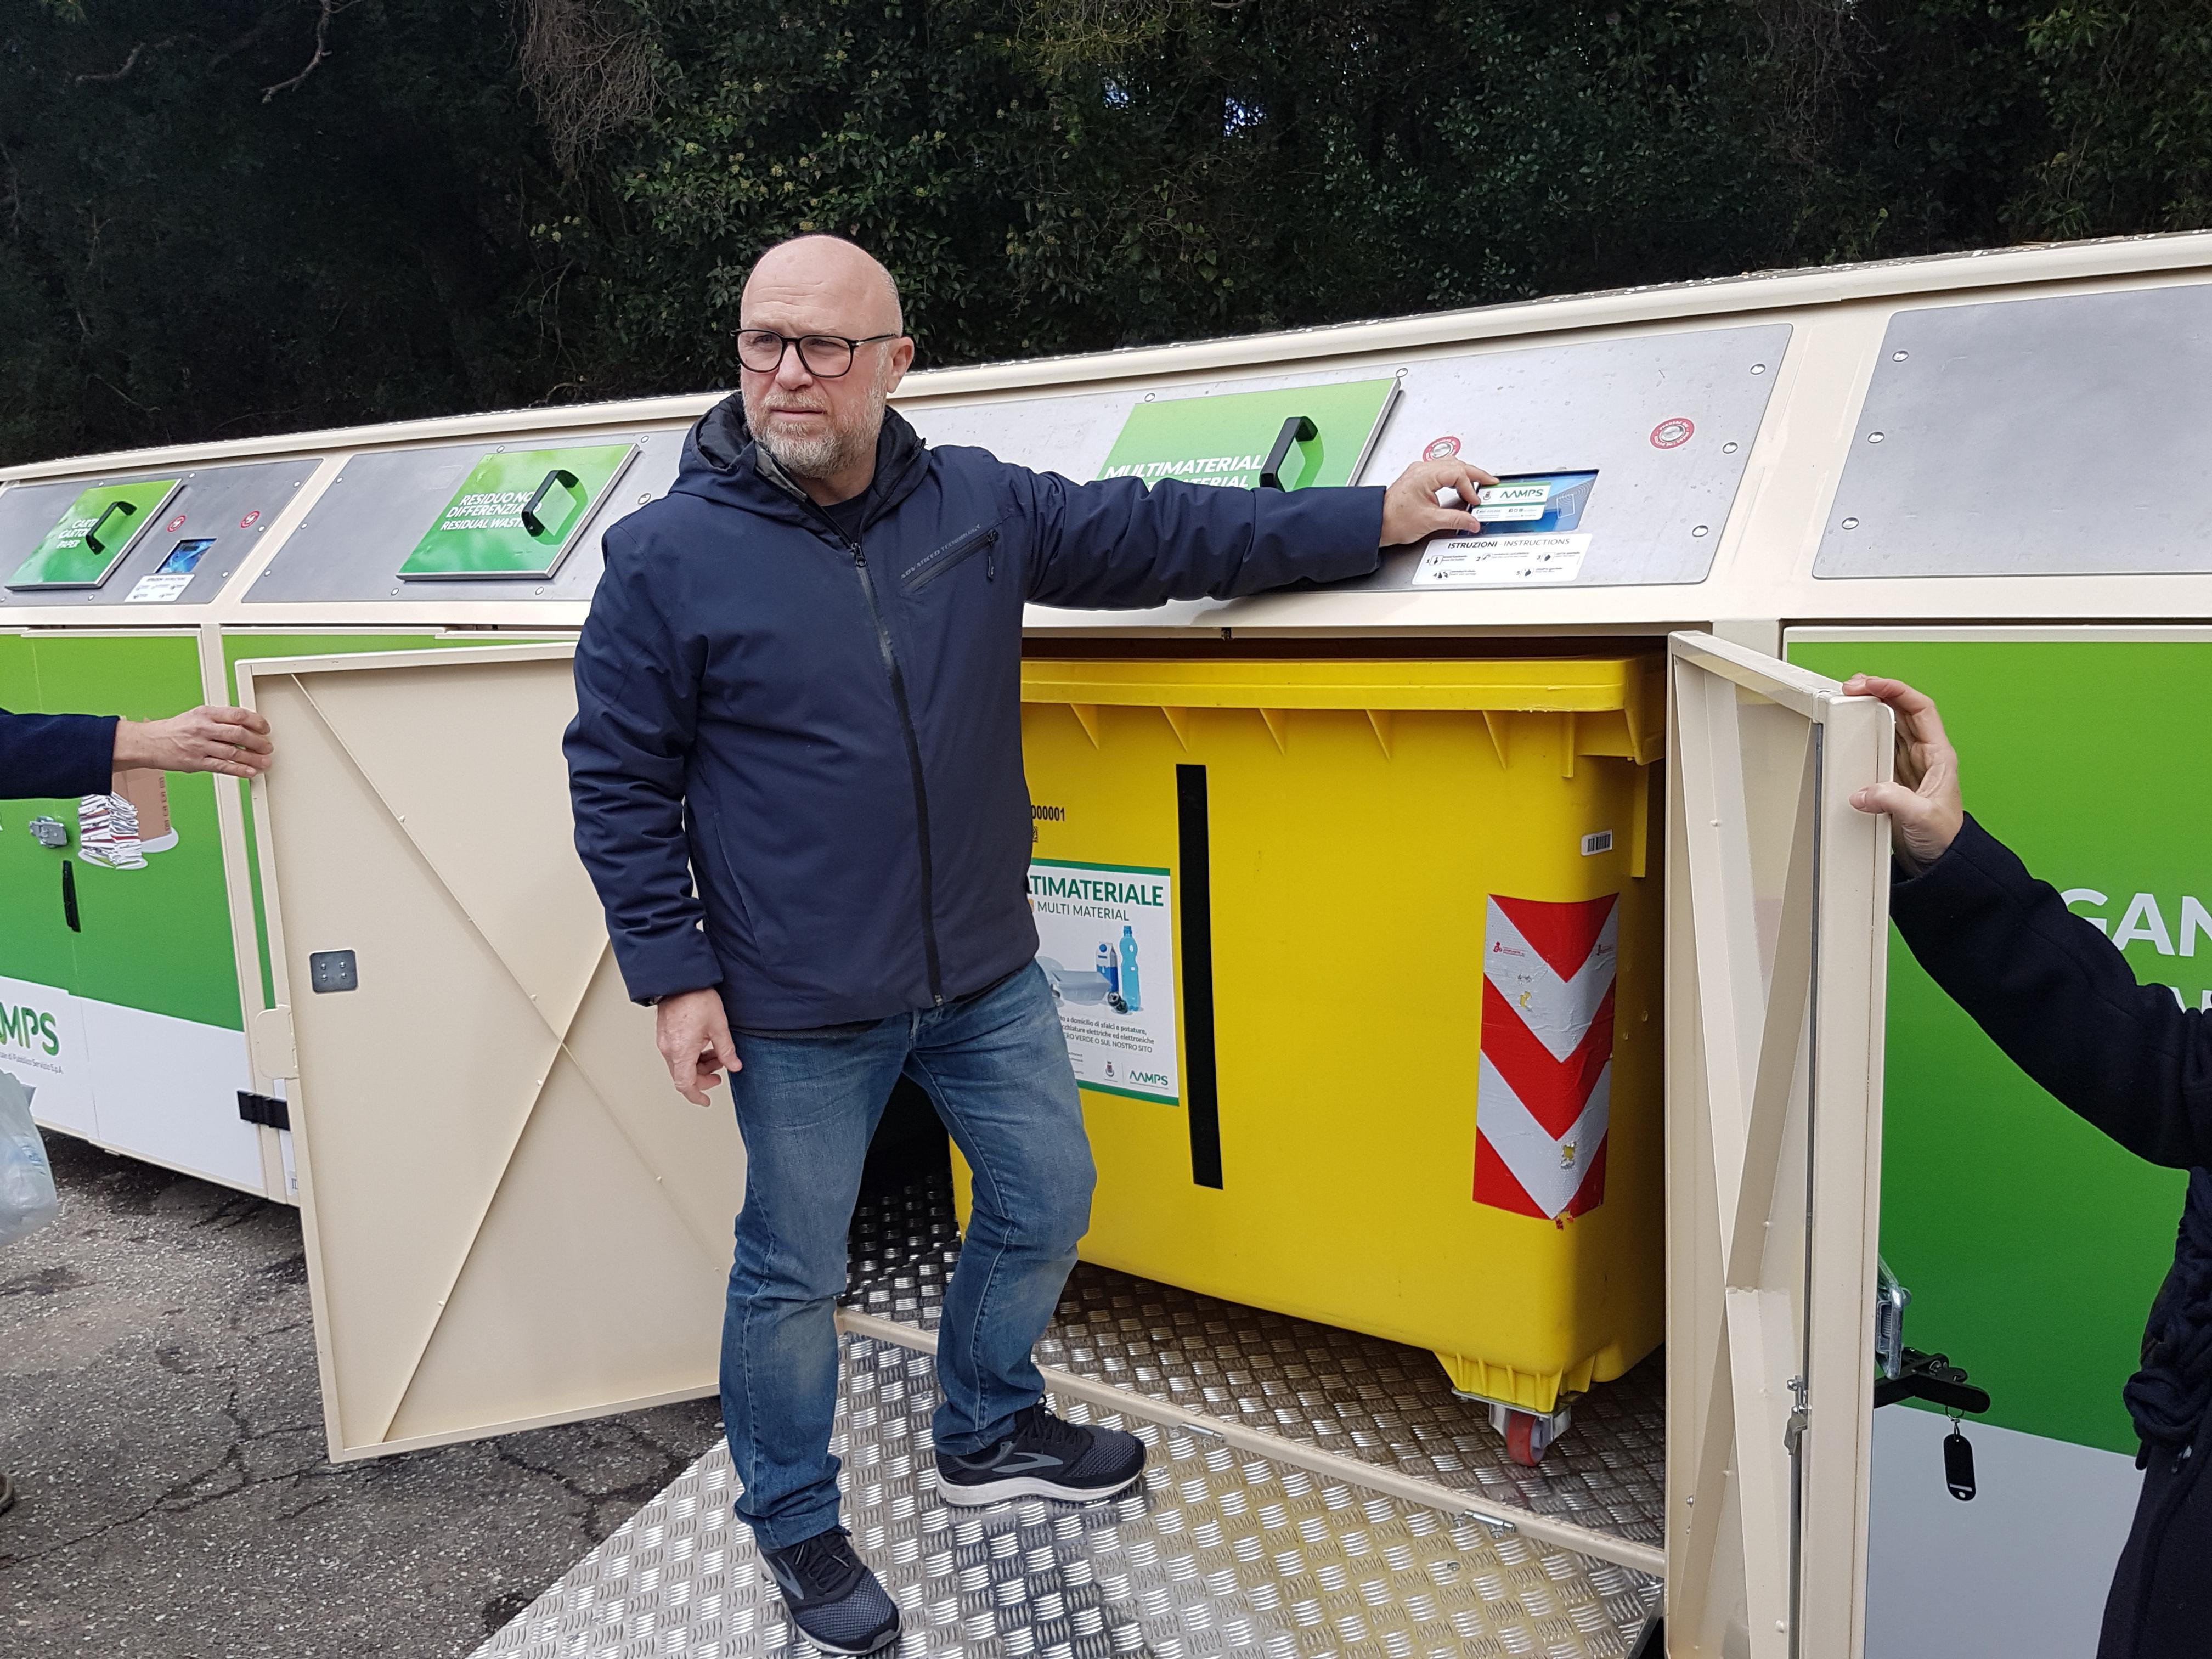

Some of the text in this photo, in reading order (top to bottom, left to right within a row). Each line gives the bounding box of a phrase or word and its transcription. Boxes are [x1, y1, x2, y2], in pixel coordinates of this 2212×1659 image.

[1103, 454, 1270, 479] MULTIMATERIAL
[459, 491, 536, 506] RESIDUO NO
[1500, 489, 1544, 498] AAMPS
[445, 501, 543, 518] DIFFERENZIAO
[440, 519, 488, 531] RESIDUAL
[900, 523, 981, 579] ADVANCED TECHNOLOGY
[1447, 538, 1571, 549] ISTRUZIONI INSTRUCTIONS
[1037, 901, 1130, 921] MULTI MATERIAL
[0, 1001, 60, 1056] MPS
[1062, 1024, 1085, 1033] cchiature
[1086, 1028, 1111, 1037] elettriche
[1120, 1034, 1154, 1044] elettroniche
[1070, 1017, 1093, 1026] domicilio
[1121, 1026, 1147, 1035] potature,
[1075, 1035, 1093, 1043] VERDE
[1112, 1041, 1137, 1051] NOSTRO
[1129, 1070, 1169, 1086] AAMPS
